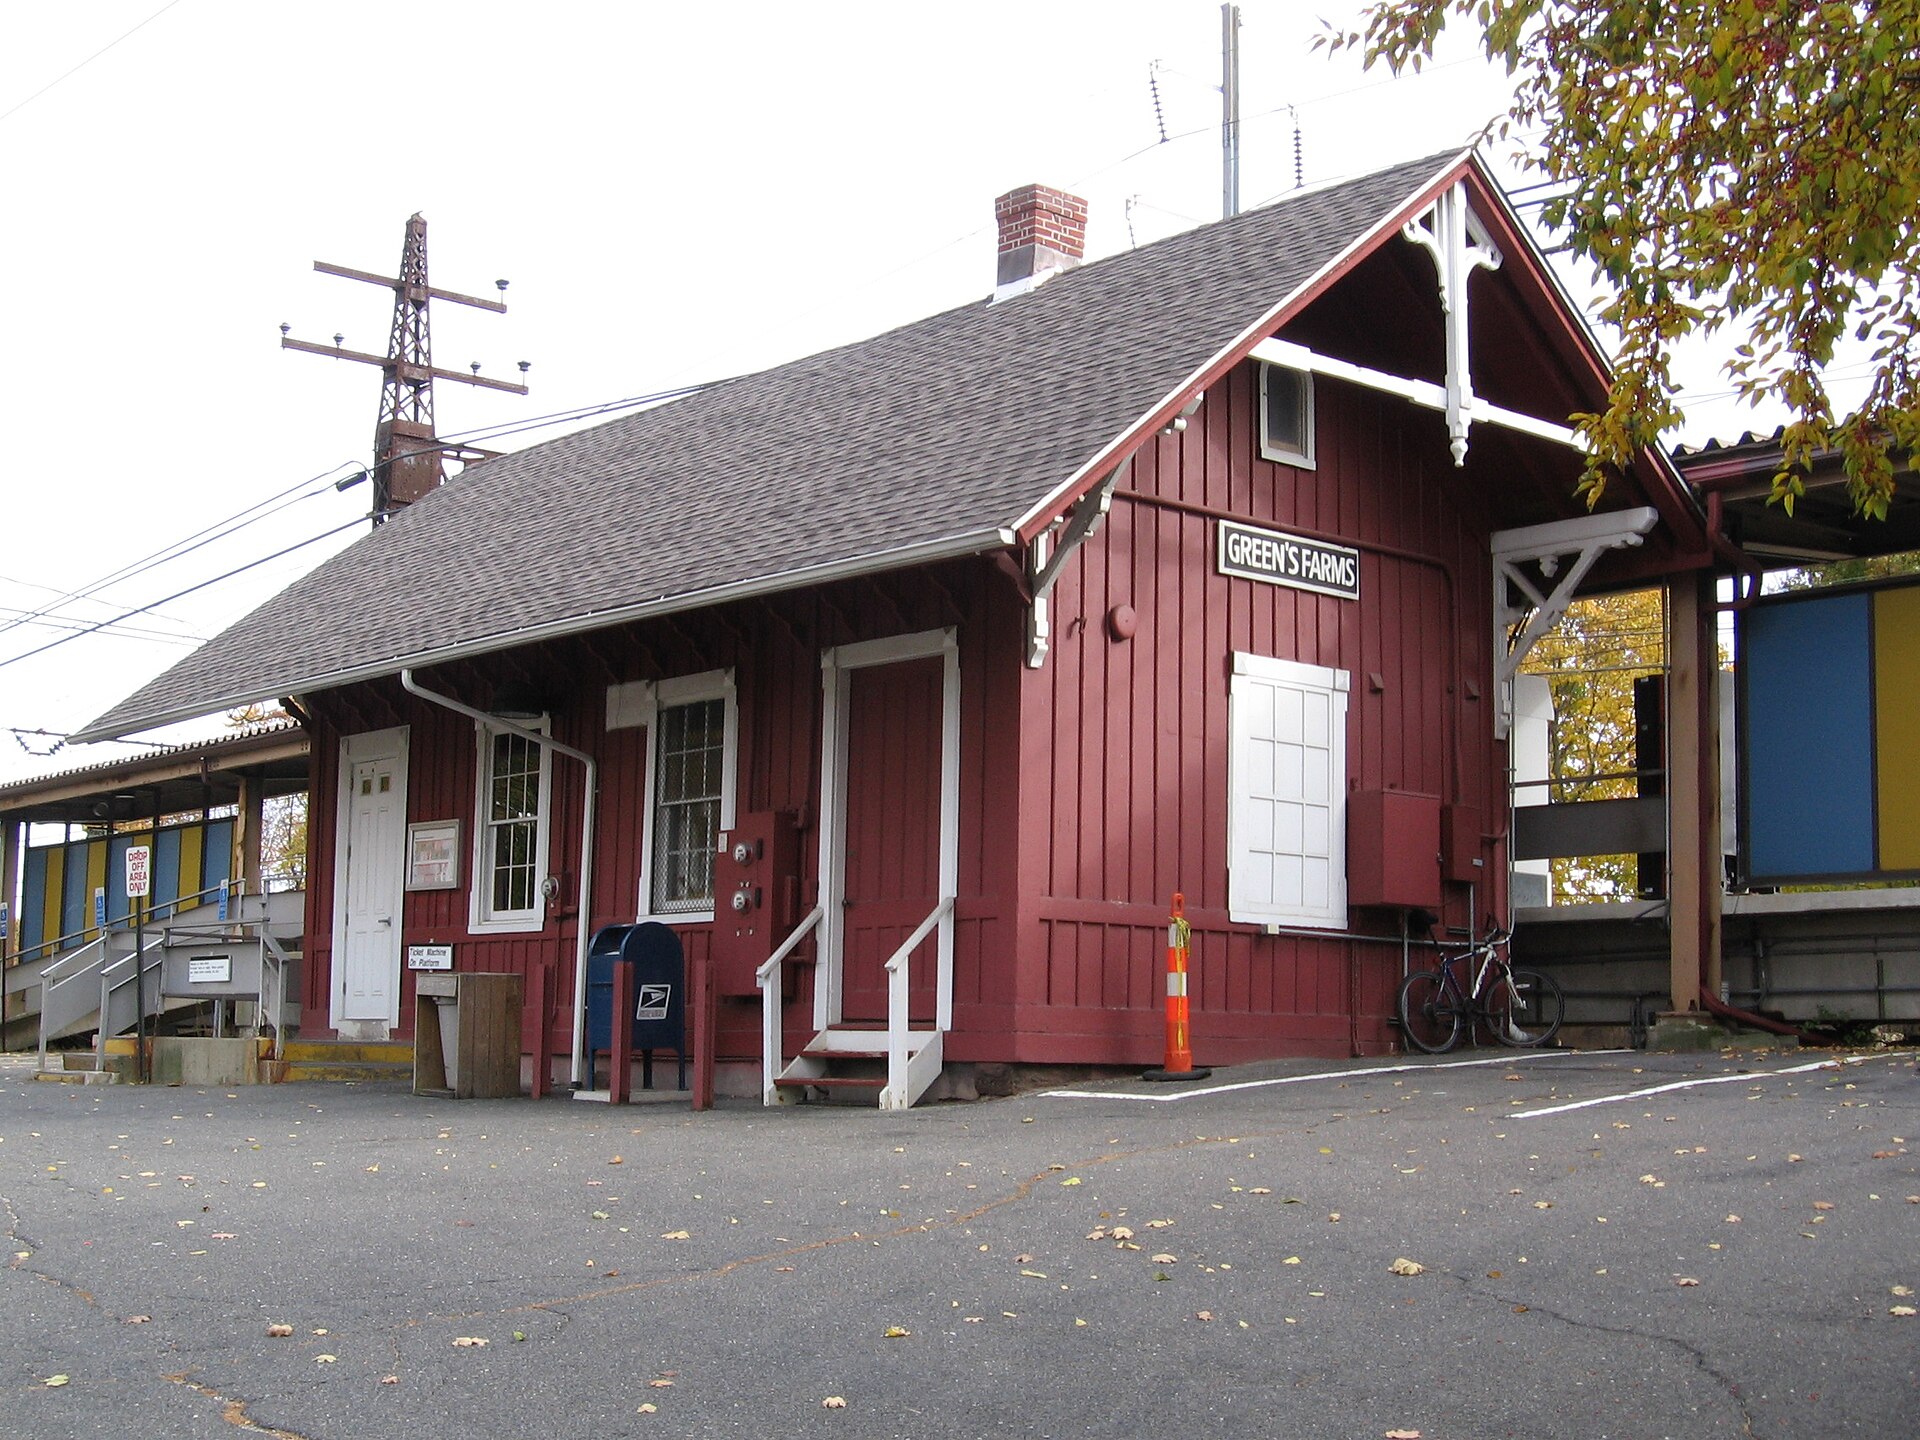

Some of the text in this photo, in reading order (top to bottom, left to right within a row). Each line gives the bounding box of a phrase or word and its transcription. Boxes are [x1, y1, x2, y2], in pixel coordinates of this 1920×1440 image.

[1228, 532, 1355, 587] GREEN'S FARMS
[128, 852, 148, 861] DROP
[131, 862, 145, 871] OFF
[129, 872, 148, 881] AREA
[129, 882, 147, 892] ONLY
[410, 948, 447, 956] Ticket Machine
[419, 959, 440, 967] Platform
